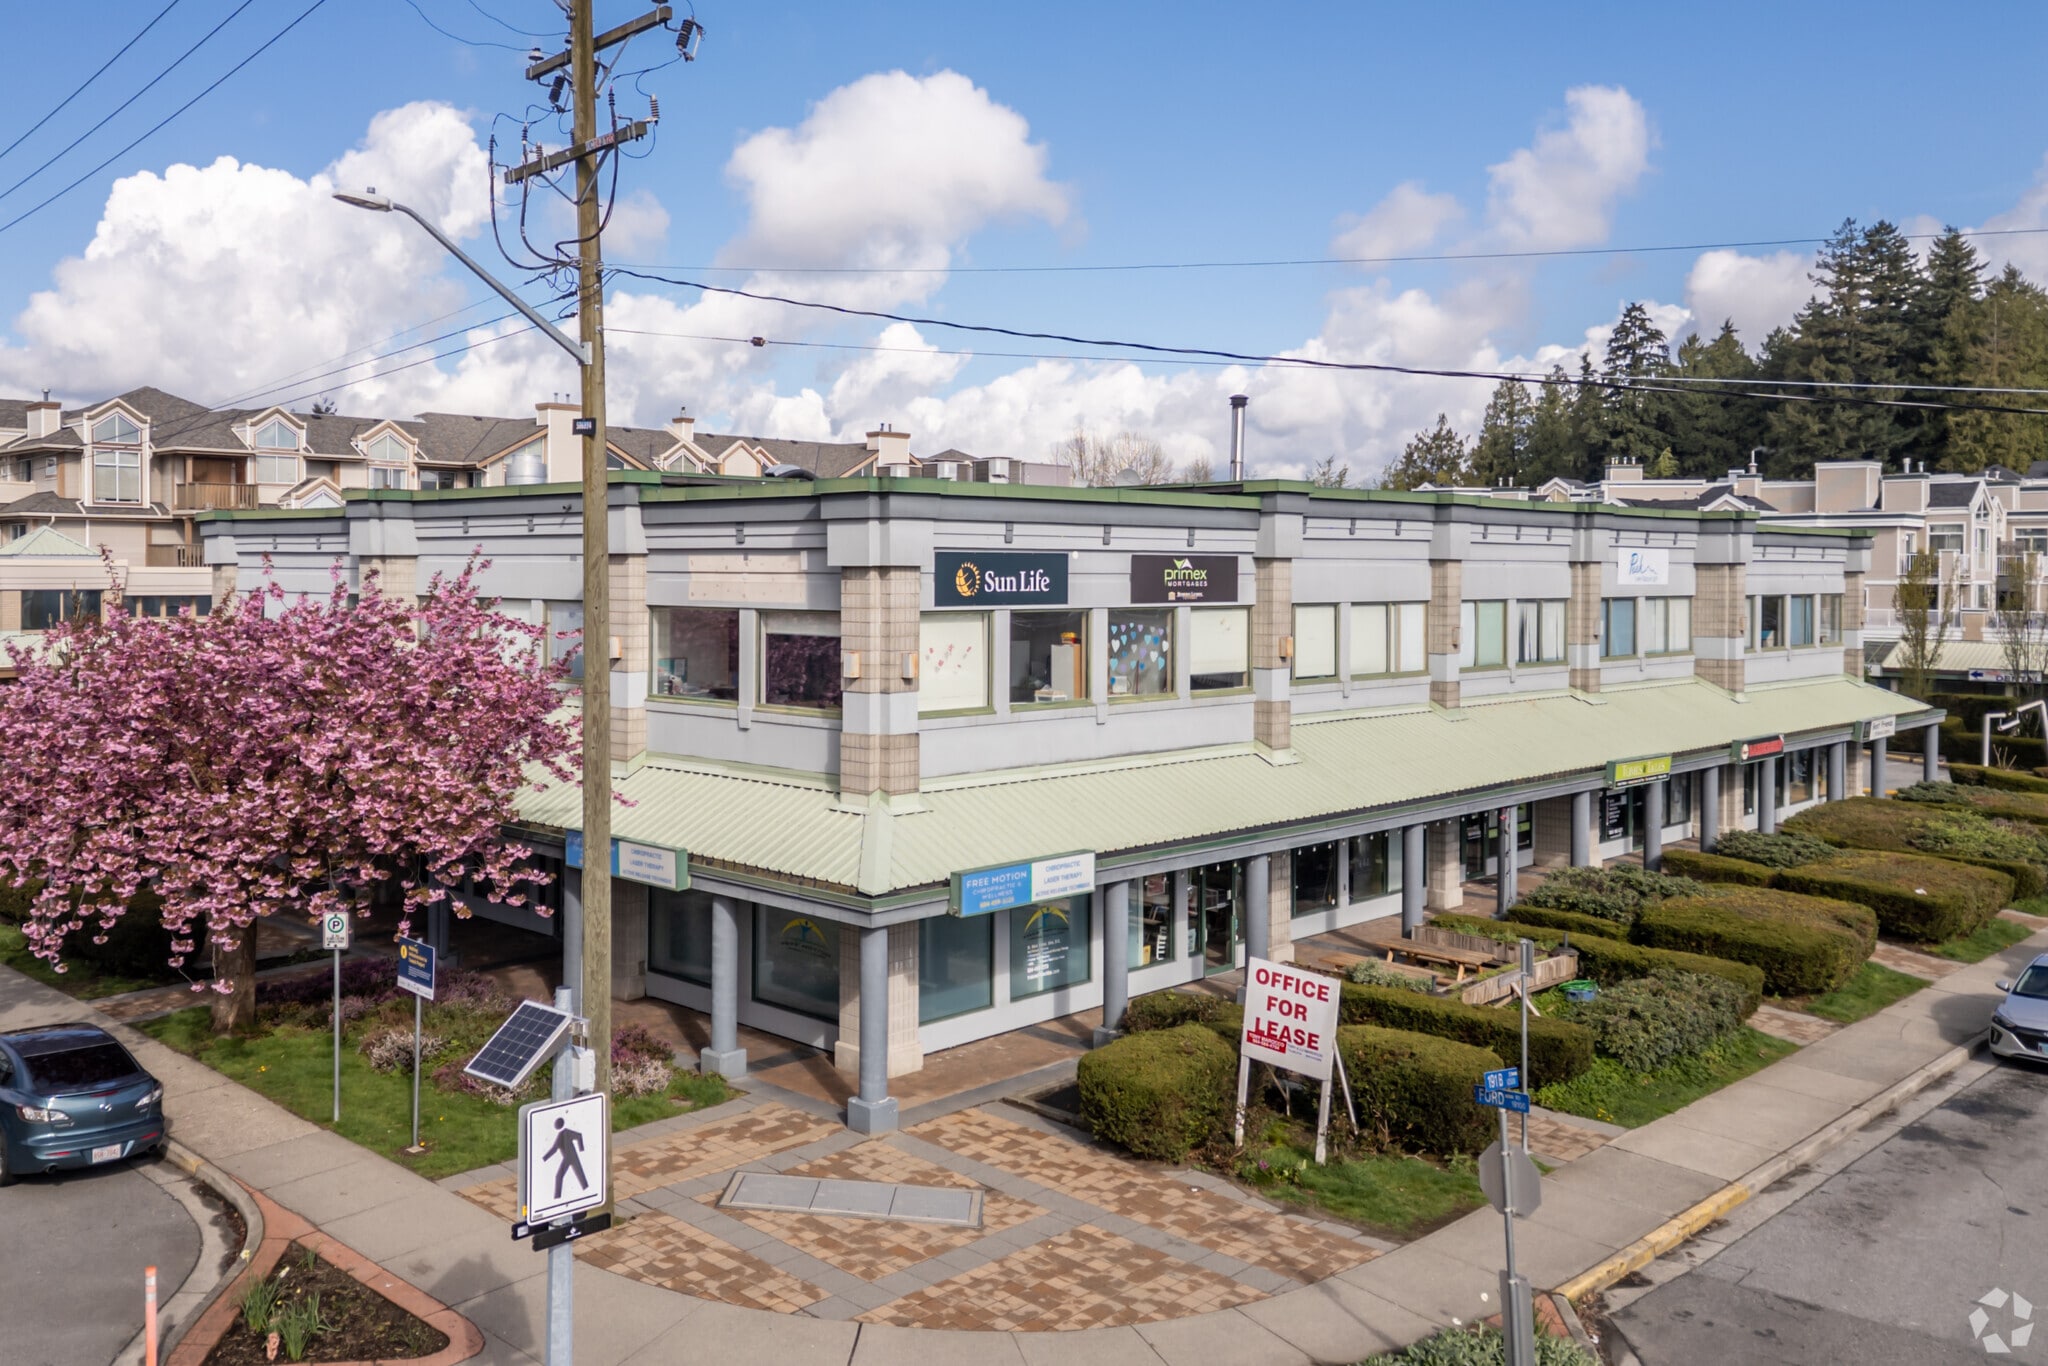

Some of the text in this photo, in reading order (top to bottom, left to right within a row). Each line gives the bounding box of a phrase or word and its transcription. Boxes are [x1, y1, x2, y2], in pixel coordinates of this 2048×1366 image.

[984, 569, 1050, 592] Sun Life
[1164, 568, 1208, 586] primex
[1045, 861, 1081, 872] CHIROPRACTIC
[966, 871, 1027, 889] FREE MOTION
[1061, 872, 1083, 881] THERAPY
[972, 883, 1015, 896] CHIROPRACTIC
[982, 889, 1014, 899] WELLNESS
[332, 920, 340, 929] P
[1255, 969, 1330, 1002] OFFICE
[1266, 995, 1308, 1022] FOR
[1254, 1017, 1320, 1051] LEASE
[1478, 1089, 1505, 1105] FORD
